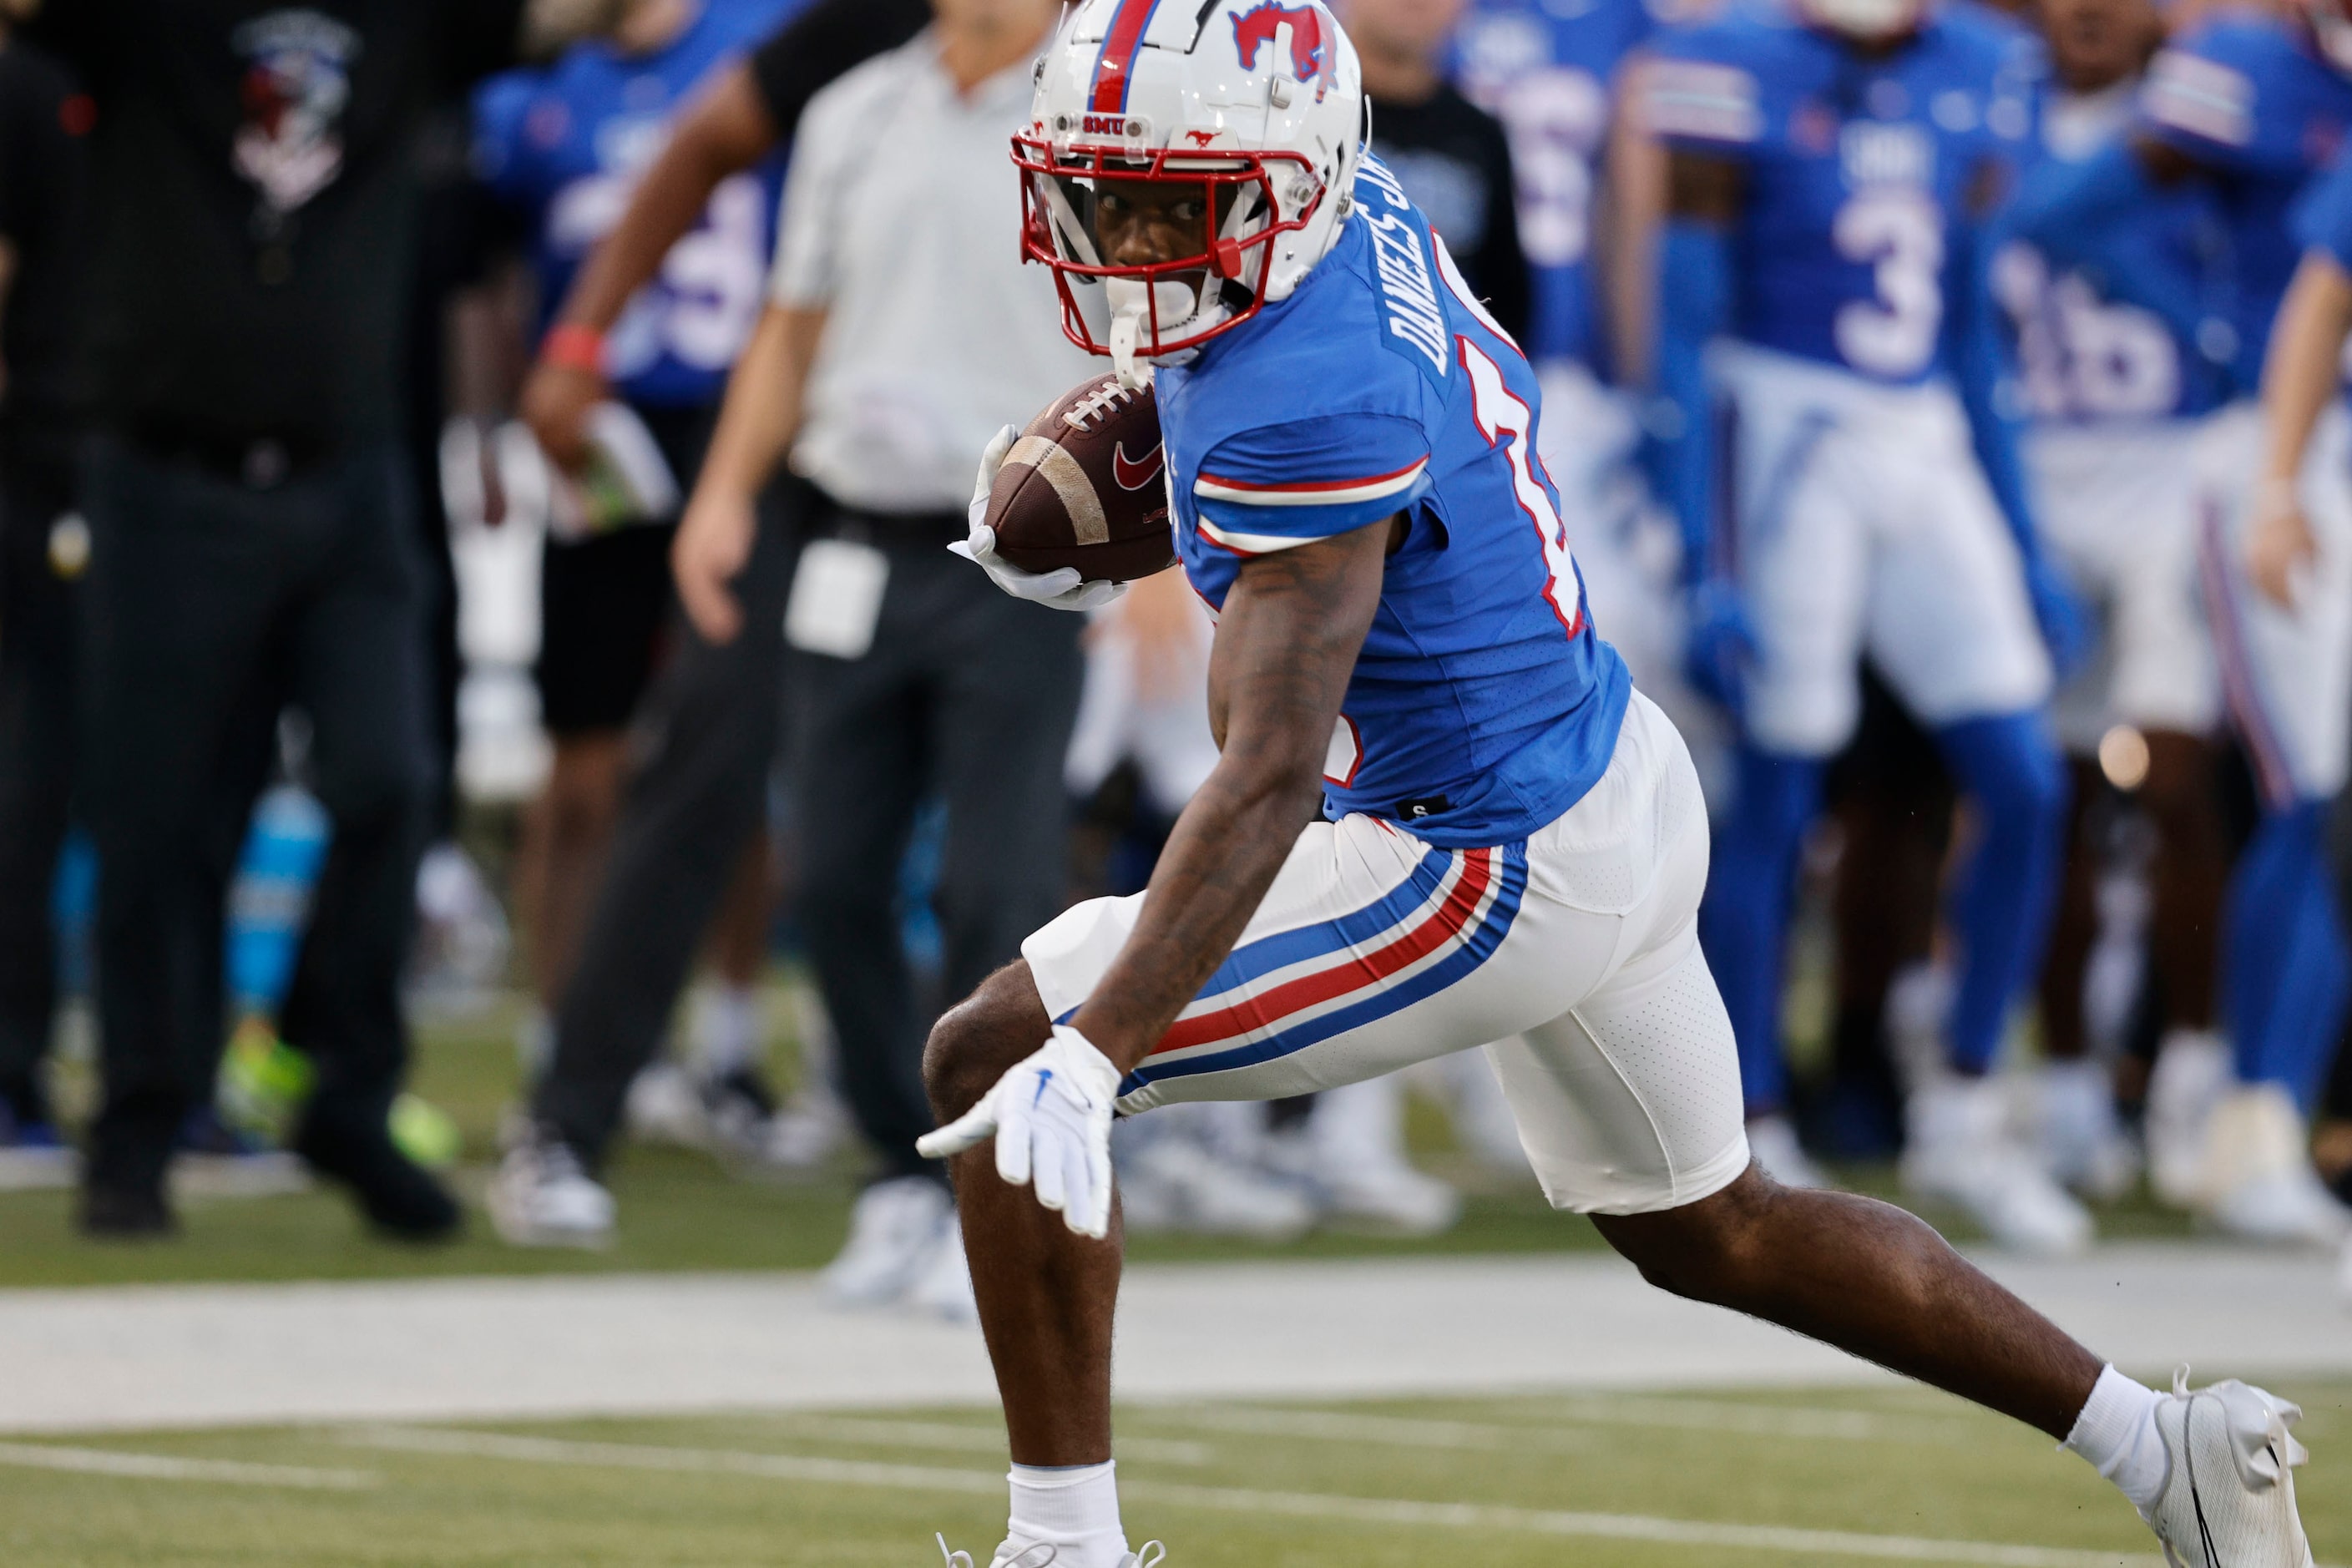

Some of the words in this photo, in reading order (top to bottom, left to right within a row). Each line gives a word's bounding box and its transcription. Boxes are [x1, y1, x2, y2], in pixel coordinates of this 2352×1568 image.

[1082, 115, 1126, 135] SMU
[1354, 201, 1449, 377] DANIELS
[1834, 184, 1944, 380] 3
